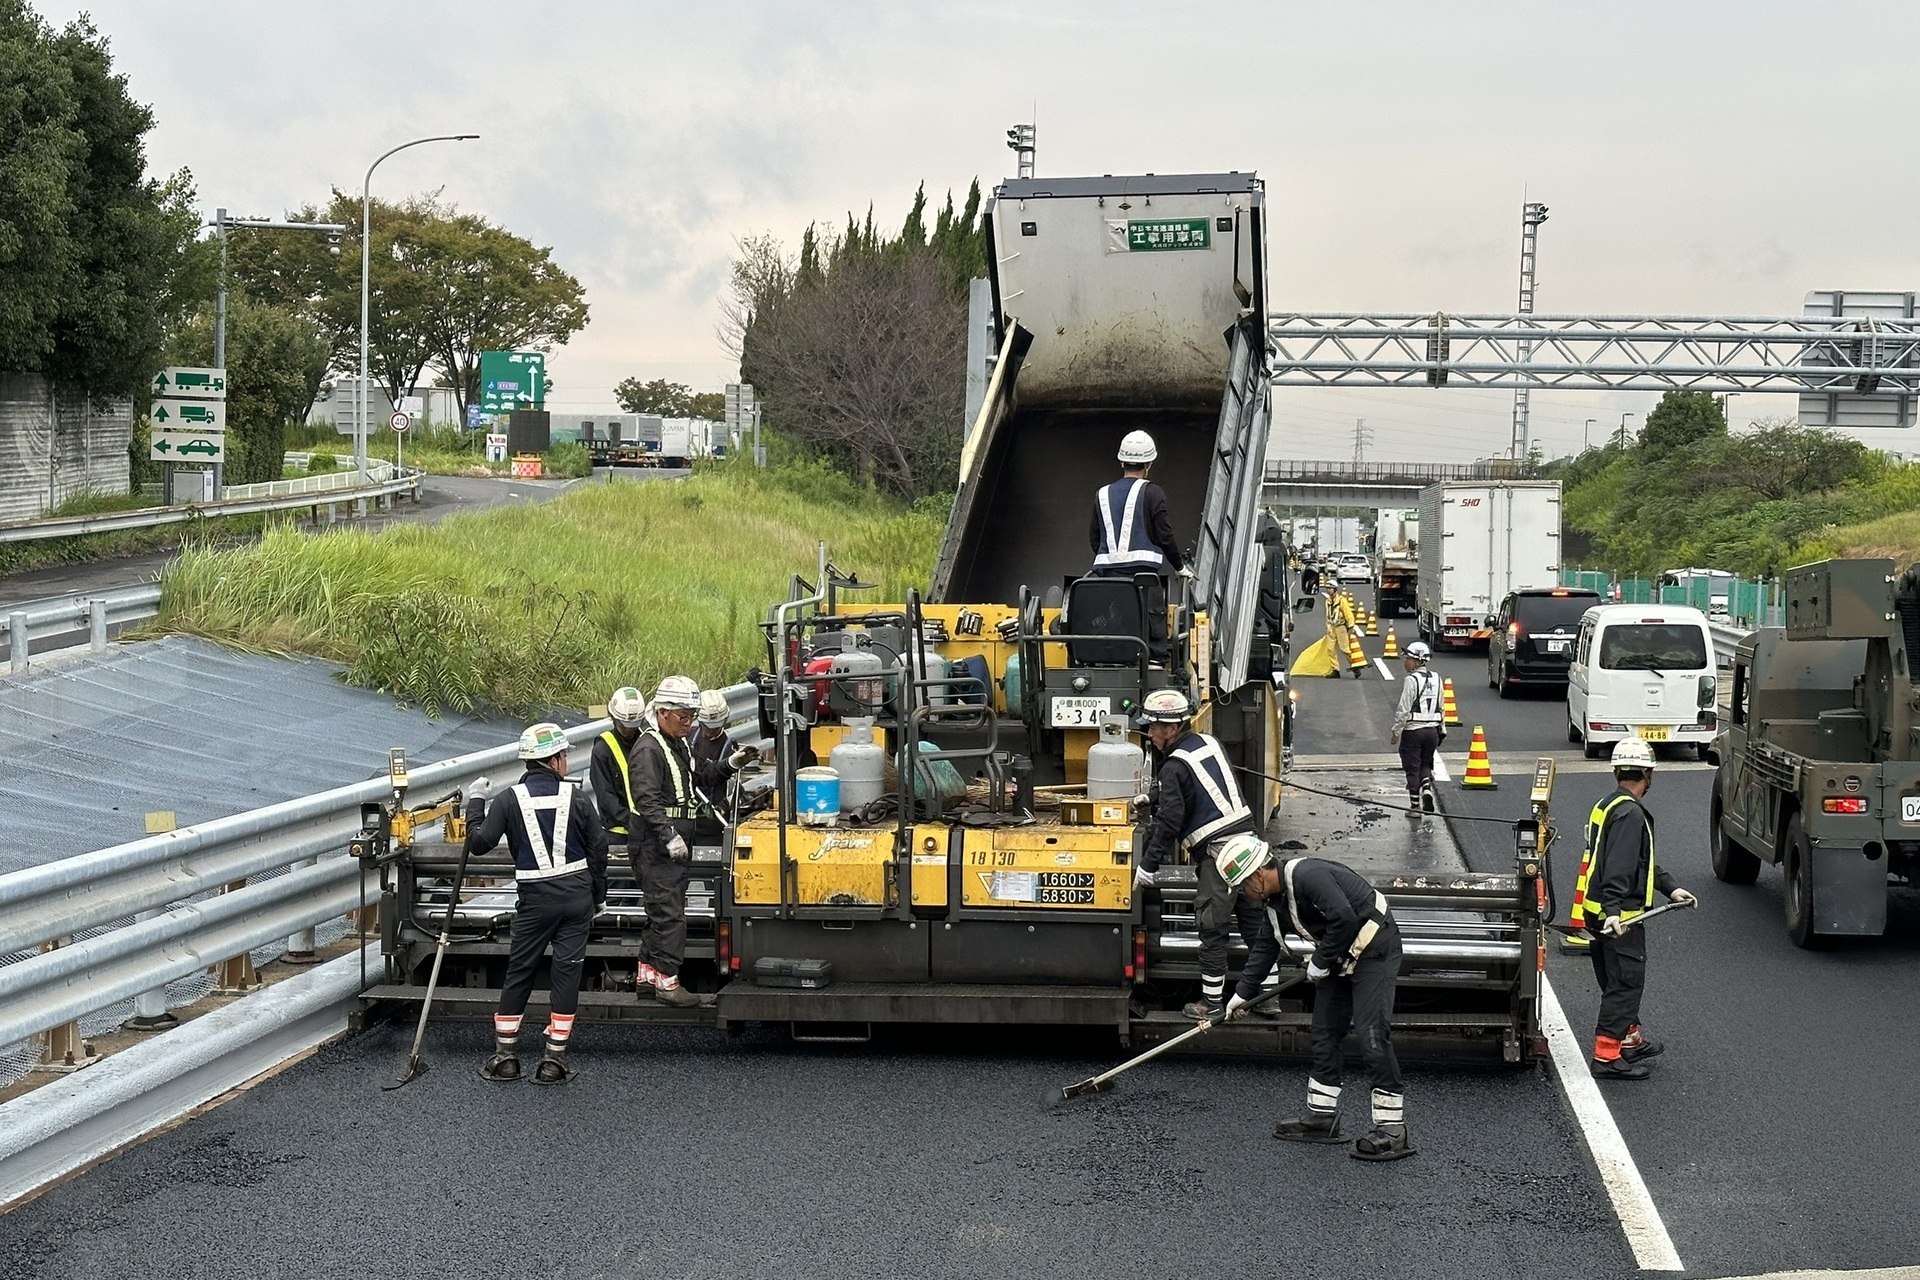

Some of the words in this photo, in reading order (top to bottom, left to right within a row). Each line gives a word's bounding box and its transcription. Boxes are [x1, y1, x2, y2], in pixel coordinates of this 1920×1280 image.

[394, 417, 406, 427] 40
[1644, 731, 1667, 740] 44-88
[1041, 872, 1094, 887] 1.660トン
[1041, 889, 1094, 904] 5.830トン
